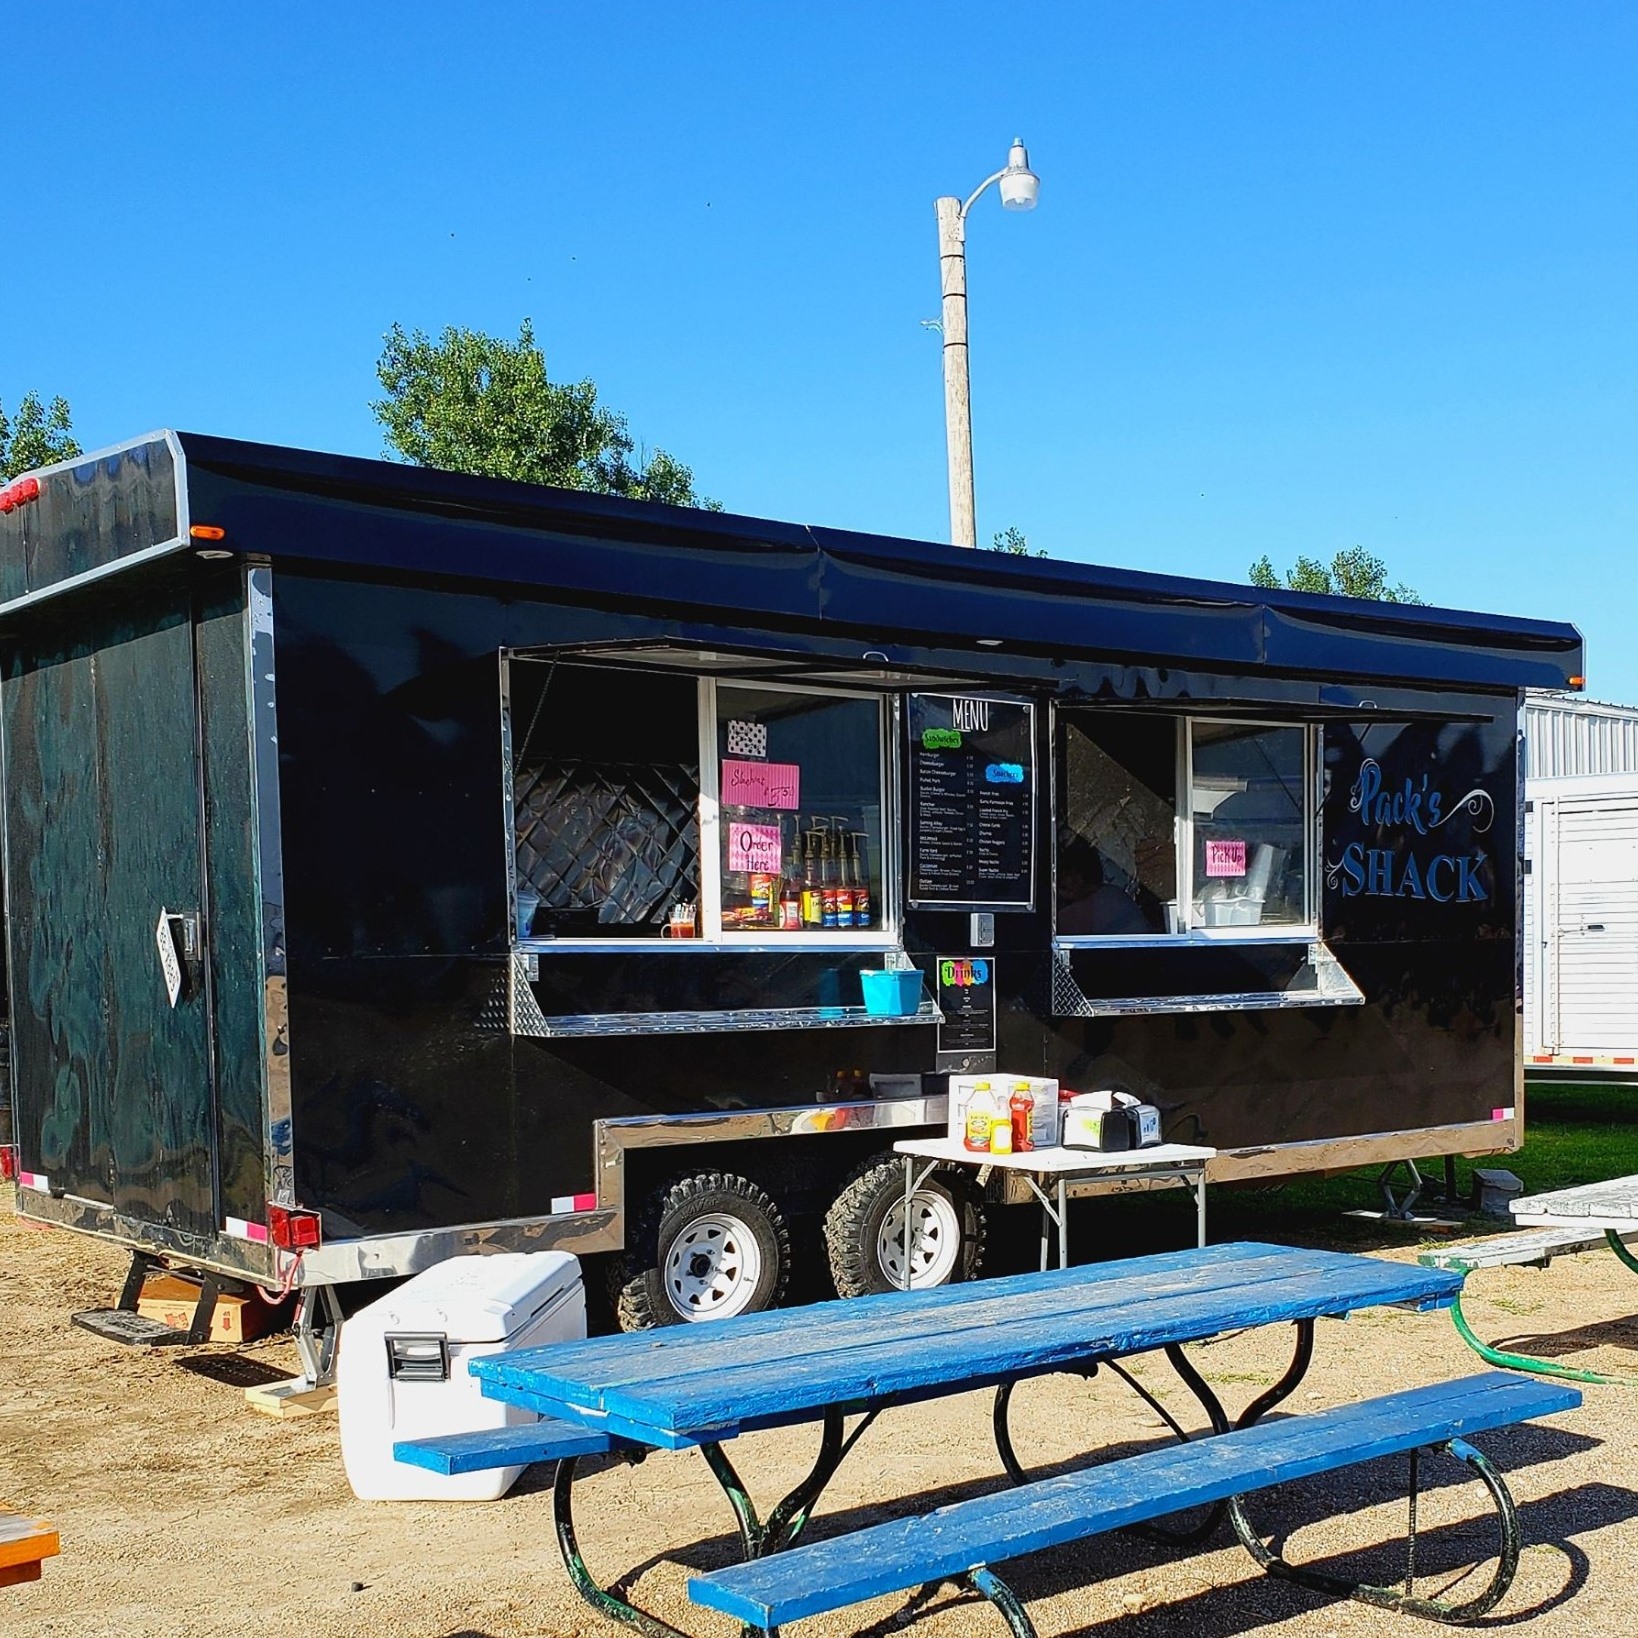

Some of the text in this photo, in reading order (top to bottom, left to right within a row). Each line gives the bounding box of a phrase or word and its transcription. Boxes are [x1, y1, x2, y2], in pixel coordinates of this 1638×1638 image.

[952, 698, 988, 732] MENU
[1350, 758, 1446, 835] Pack's
[740, 830, 774, 852] Order
[746, 855, 770, 871] Here
[1341, 842, 1489, 903] SHACK
[944, 966, 983, 980] Drinks
